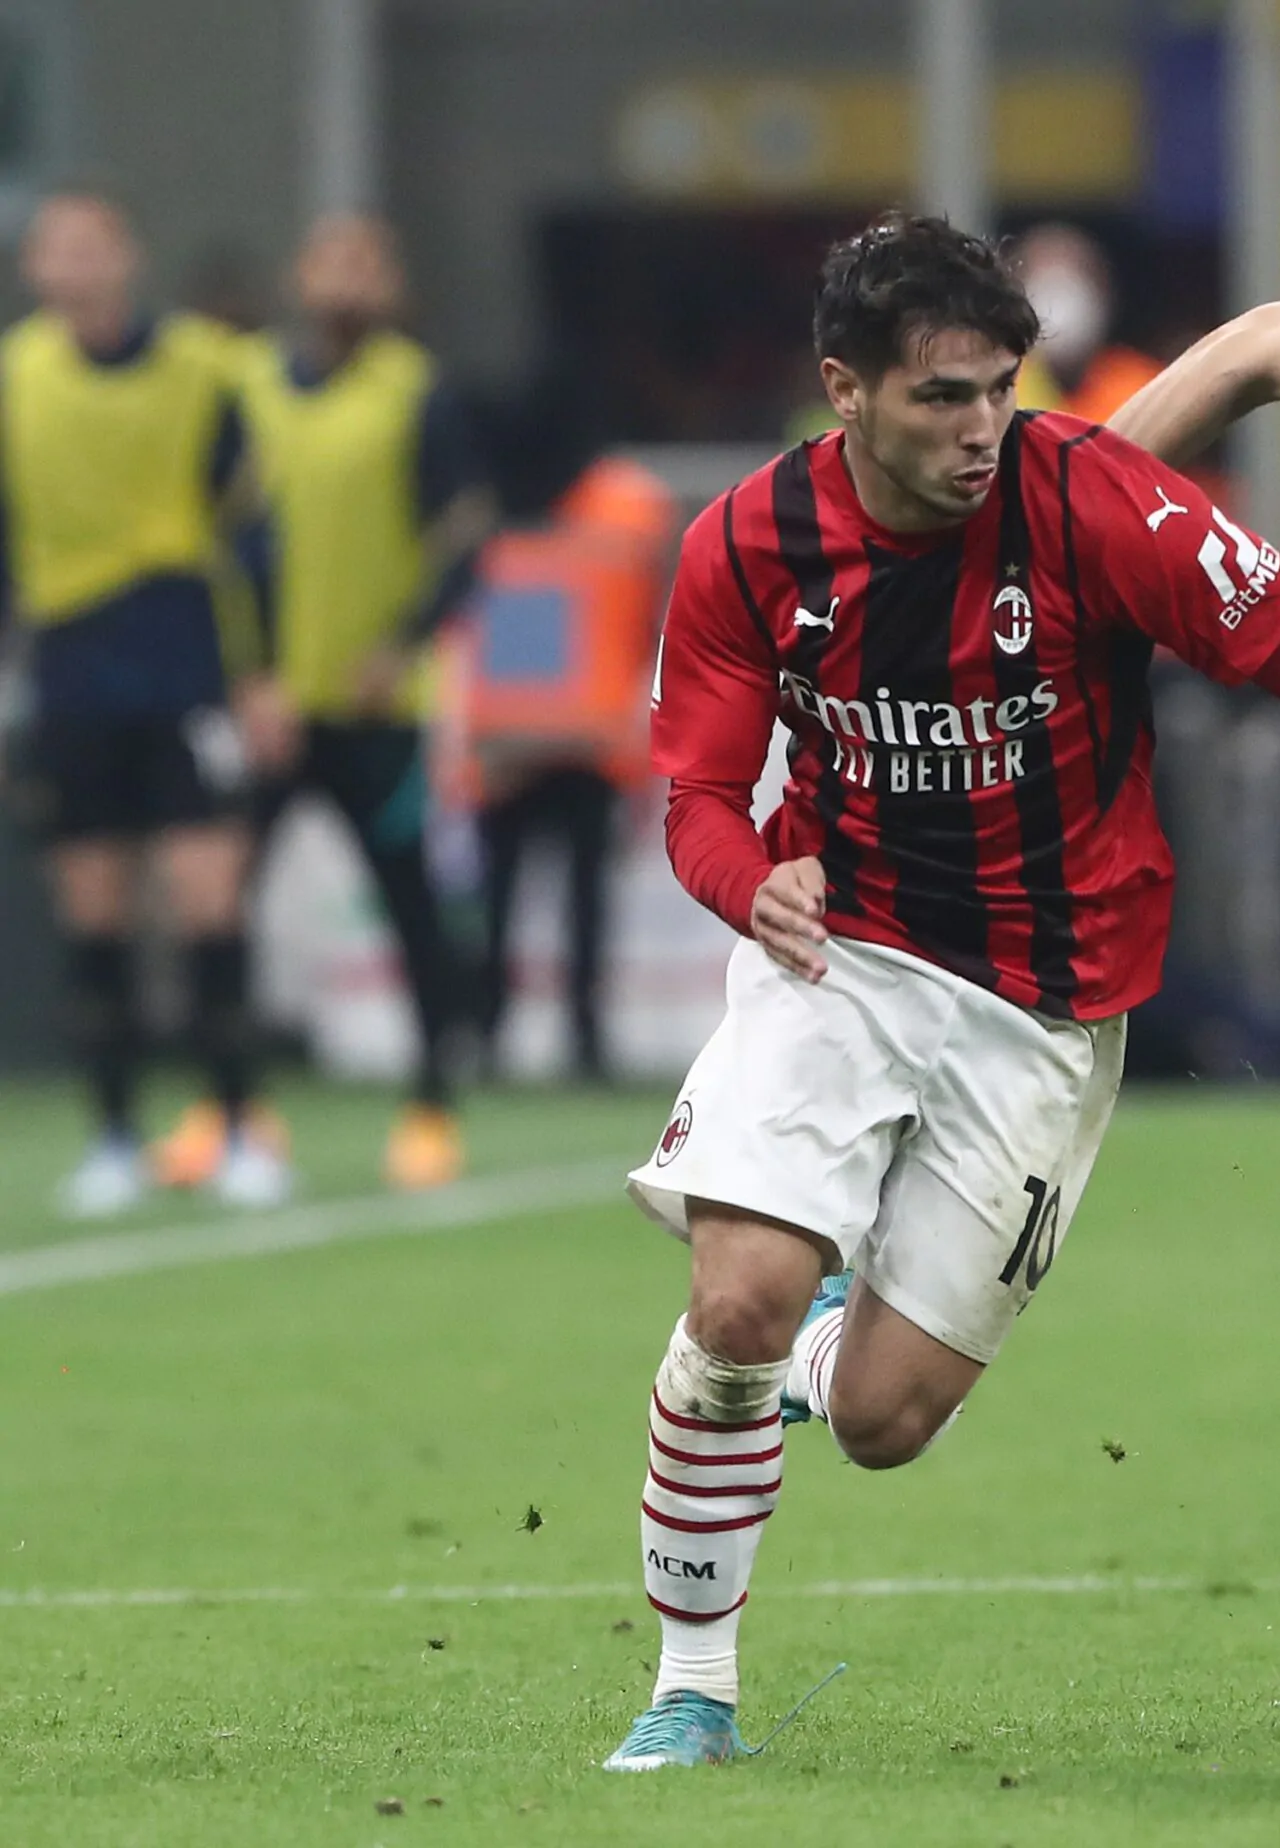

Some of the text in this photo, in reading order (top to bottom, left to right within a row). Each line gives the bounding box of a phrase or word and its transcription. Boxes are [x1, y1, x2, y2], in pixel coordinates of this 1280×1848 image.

[1219, 541, 1280, 630] BitME
[832, 738, 1025, 793] FLY BETTER
[998, 1174, 1061, 1292] 10
[647, 1548, 717, 1580] ACM
